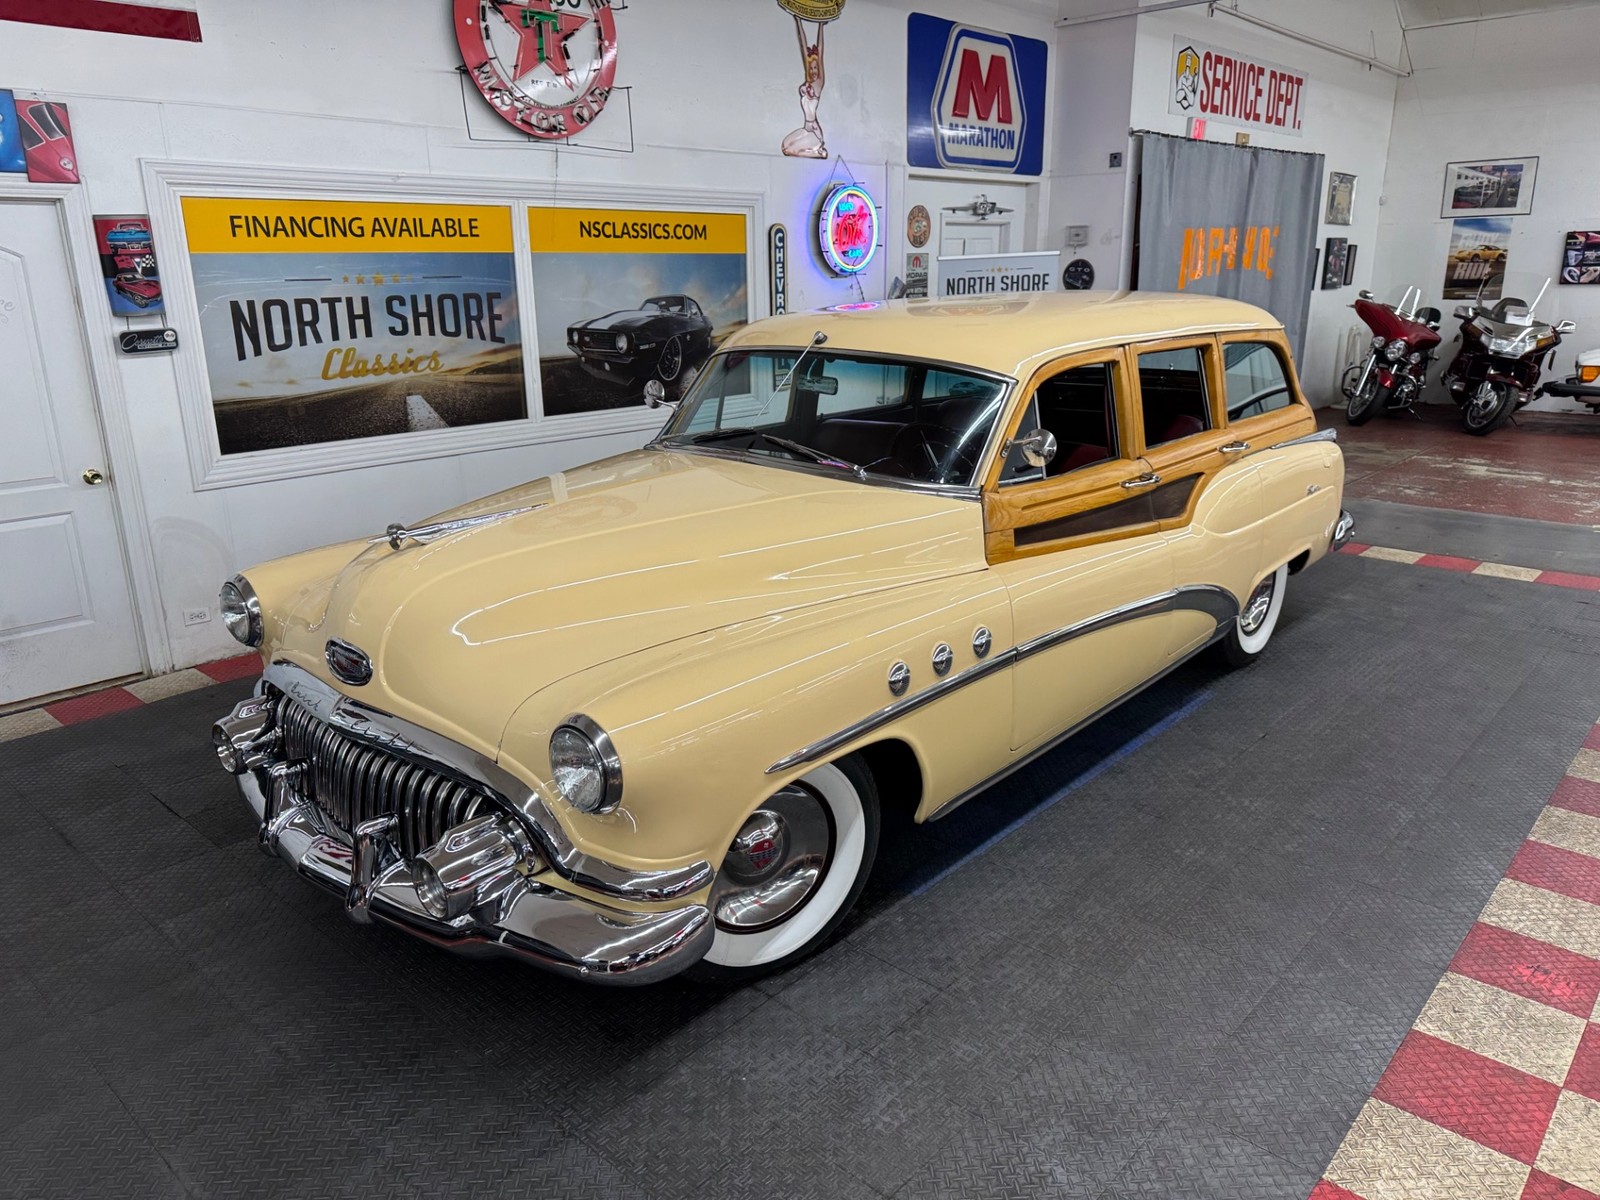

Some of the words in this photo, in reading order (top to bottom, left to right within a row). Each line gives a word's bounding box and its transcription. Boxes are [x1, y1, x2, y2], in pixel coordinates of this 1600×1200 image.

[474, 60, 568, 136] MOTOR
[1200, 51, 1265, 122] SERVICE
[1265, 70, 1304, 130] DEPT.
[947, 122, 1015, 150] MARATHON
[229, 215, 365, 238] FINANCING
[371, 217, 480, 238] AVAILABLE
[579, 221, 707, 240] NSCLASSICS.COM
[906, 271, 928, 279] MOPAR
[946, 275, 995, 296] NORTH
[229, 296, 373, 361] NORTH
[385, 292, 506, 344] SHORE
[321, 347, 445, 381] Classics
